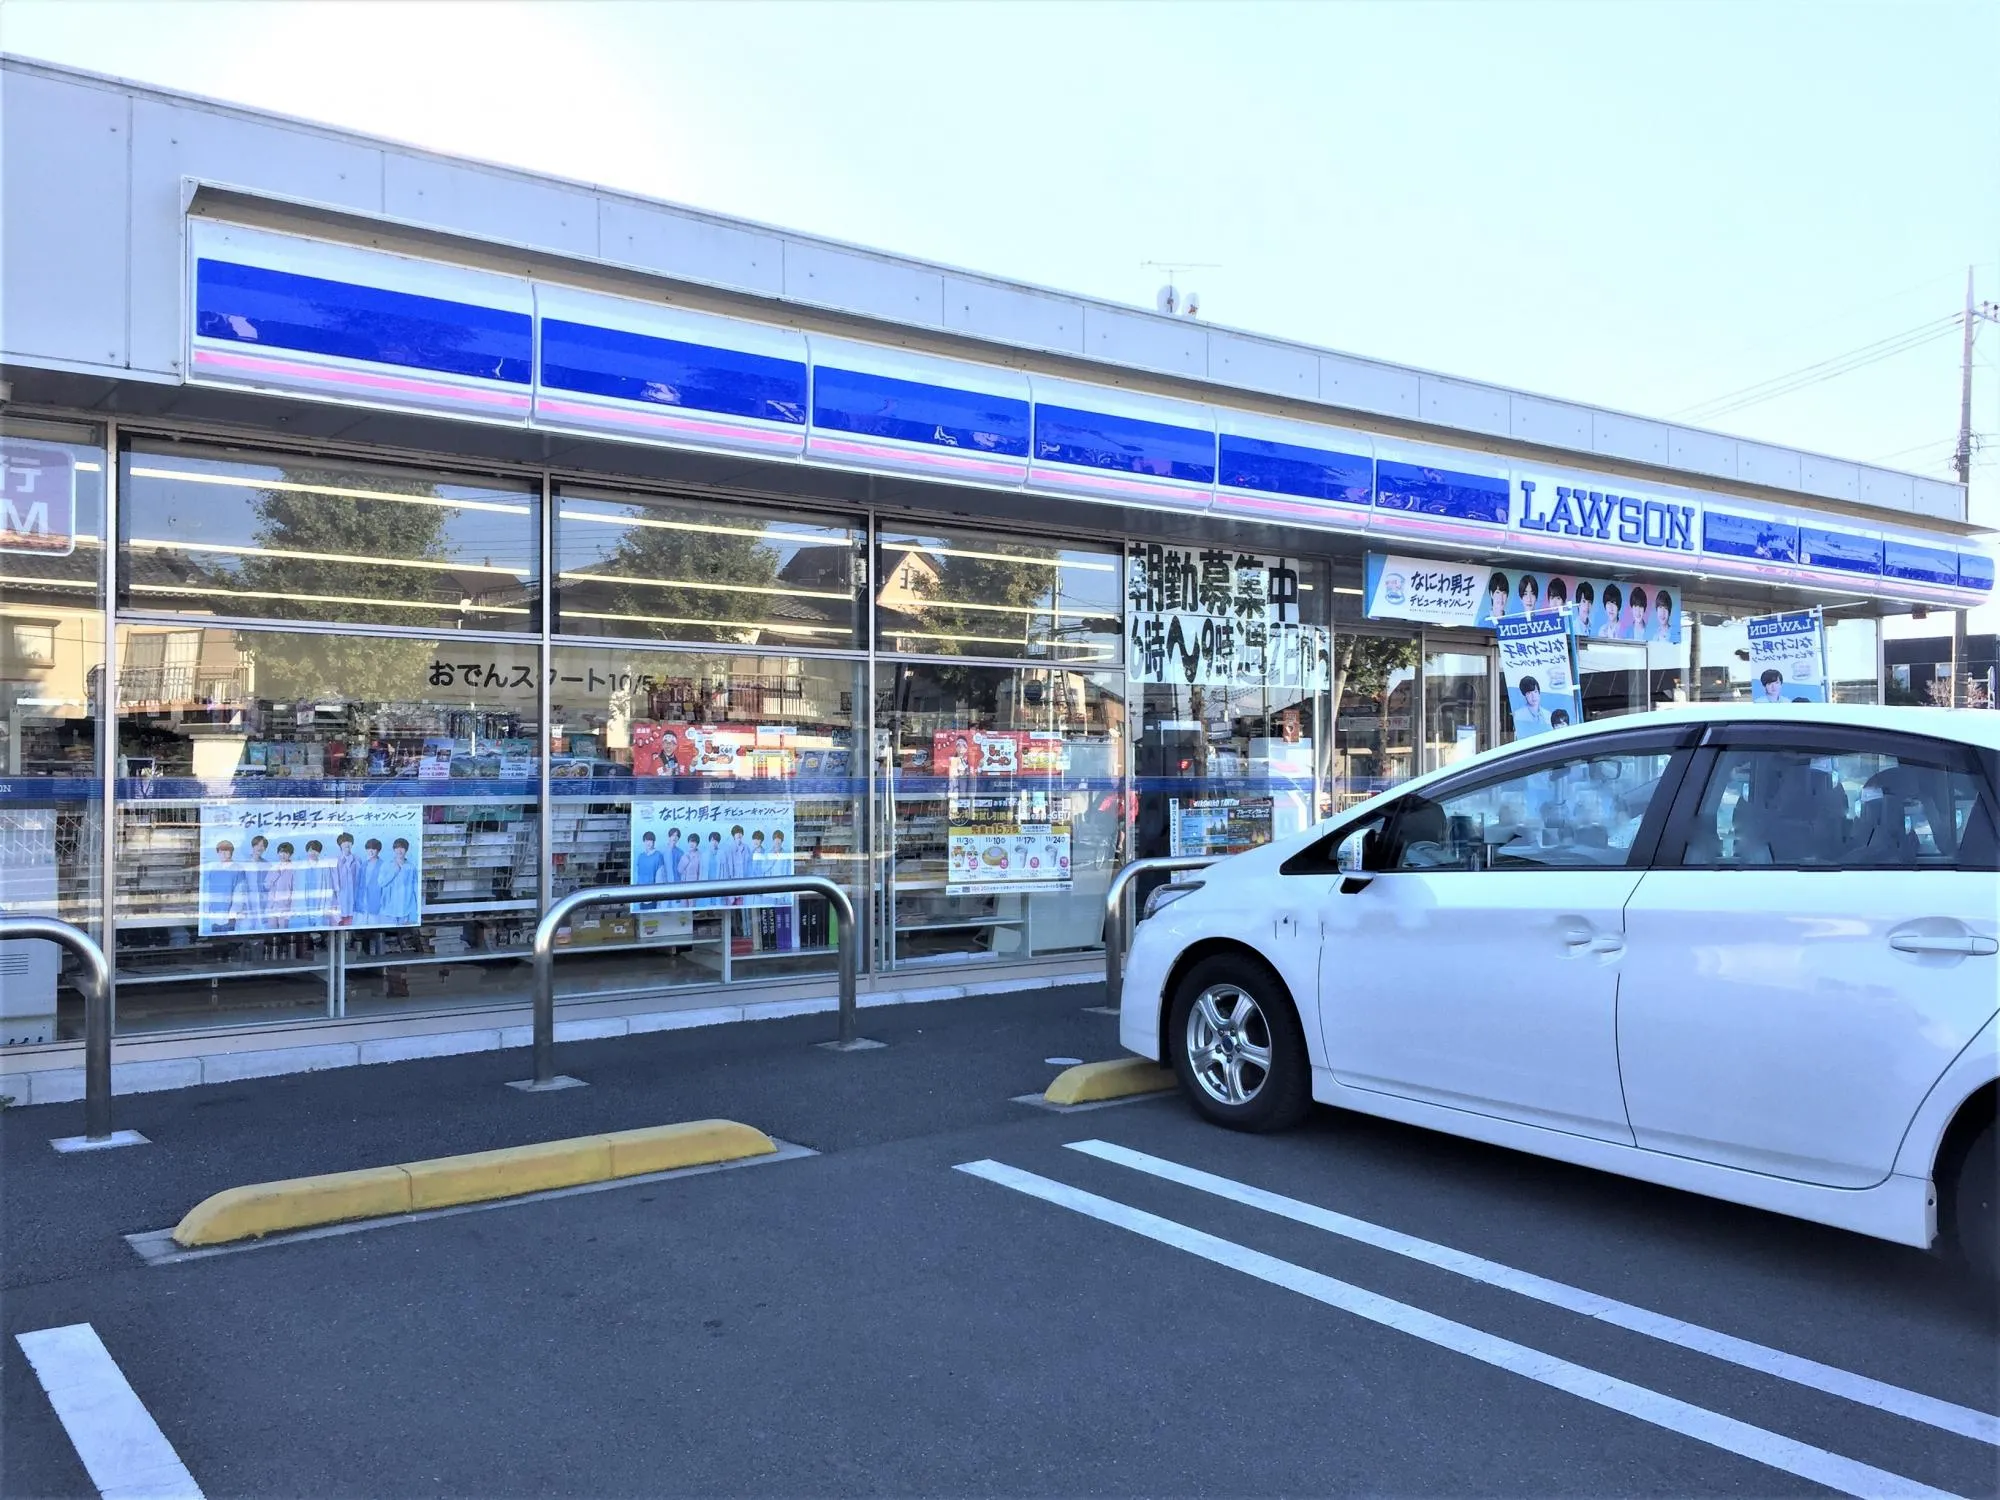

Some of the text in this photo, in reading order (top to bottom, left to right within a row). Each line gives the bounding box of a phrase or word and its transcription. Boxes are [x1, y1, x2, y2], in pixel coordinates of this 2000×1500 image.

[1520, 480, 1694, 550] LAWSON
[1129, 542, 1298, 622] 朝勤募集中
[1411, 571, 1475, 596] なにわ男子
[1410, 594, 1474, 610] デビューキャンペーン
[429, 660, 655, 694] おでんスート10/5
[327, 811, 416, 822] デビューキャンペーン
[659, 805, 722, 822] なにわ男子
[723, 806, 789, 817] デビューキャンペーン
